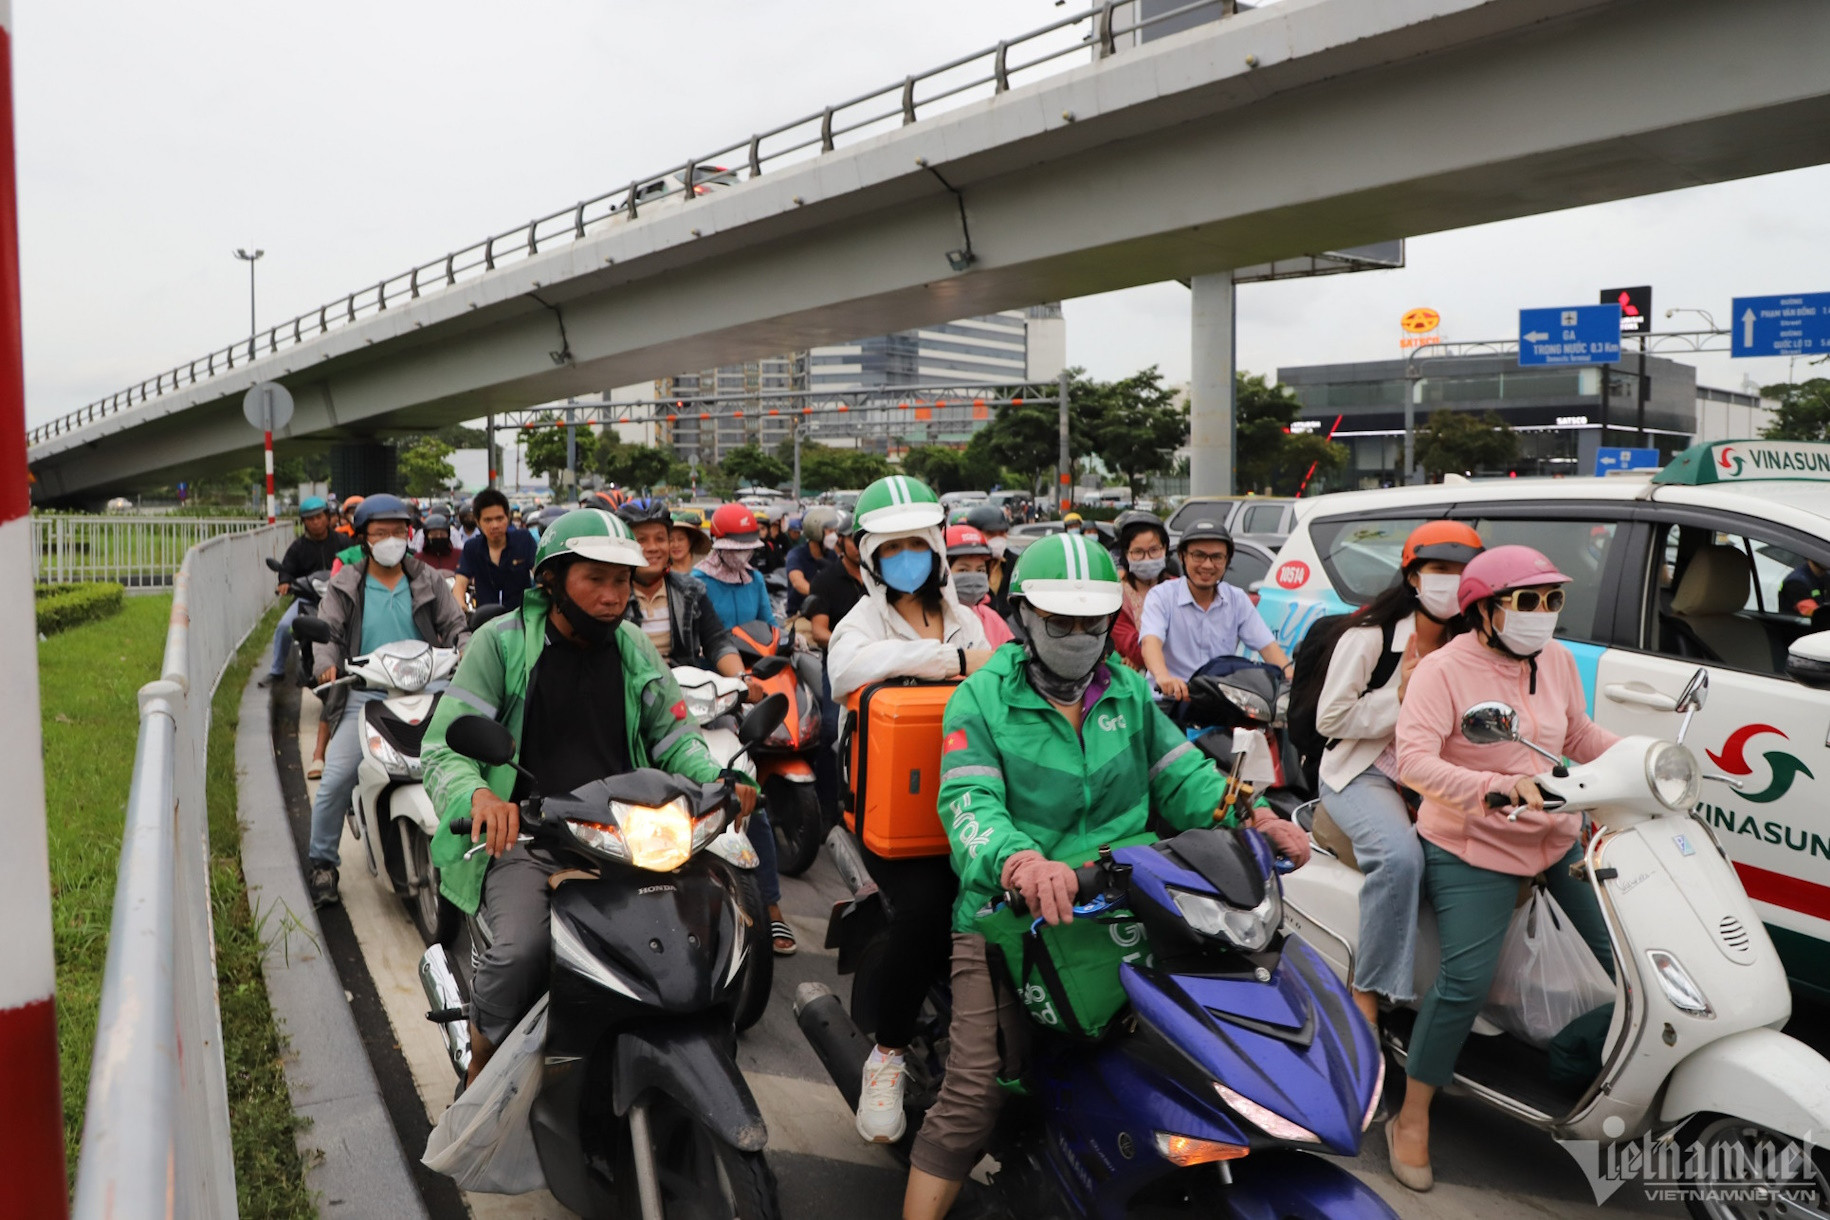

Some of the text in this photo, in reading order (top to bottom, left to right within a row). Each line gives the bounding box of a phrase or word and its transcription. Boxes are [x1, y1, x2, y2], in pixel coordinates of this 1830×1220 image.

[1562, 330, 1576, 341] GA
[1533, 343, 1562, 355] TRONG
[1748, 448, 1830, 473] VINASUN
[1280, 565, 1305, 585] 10514
[638, 885, 678, 895] HONDA
